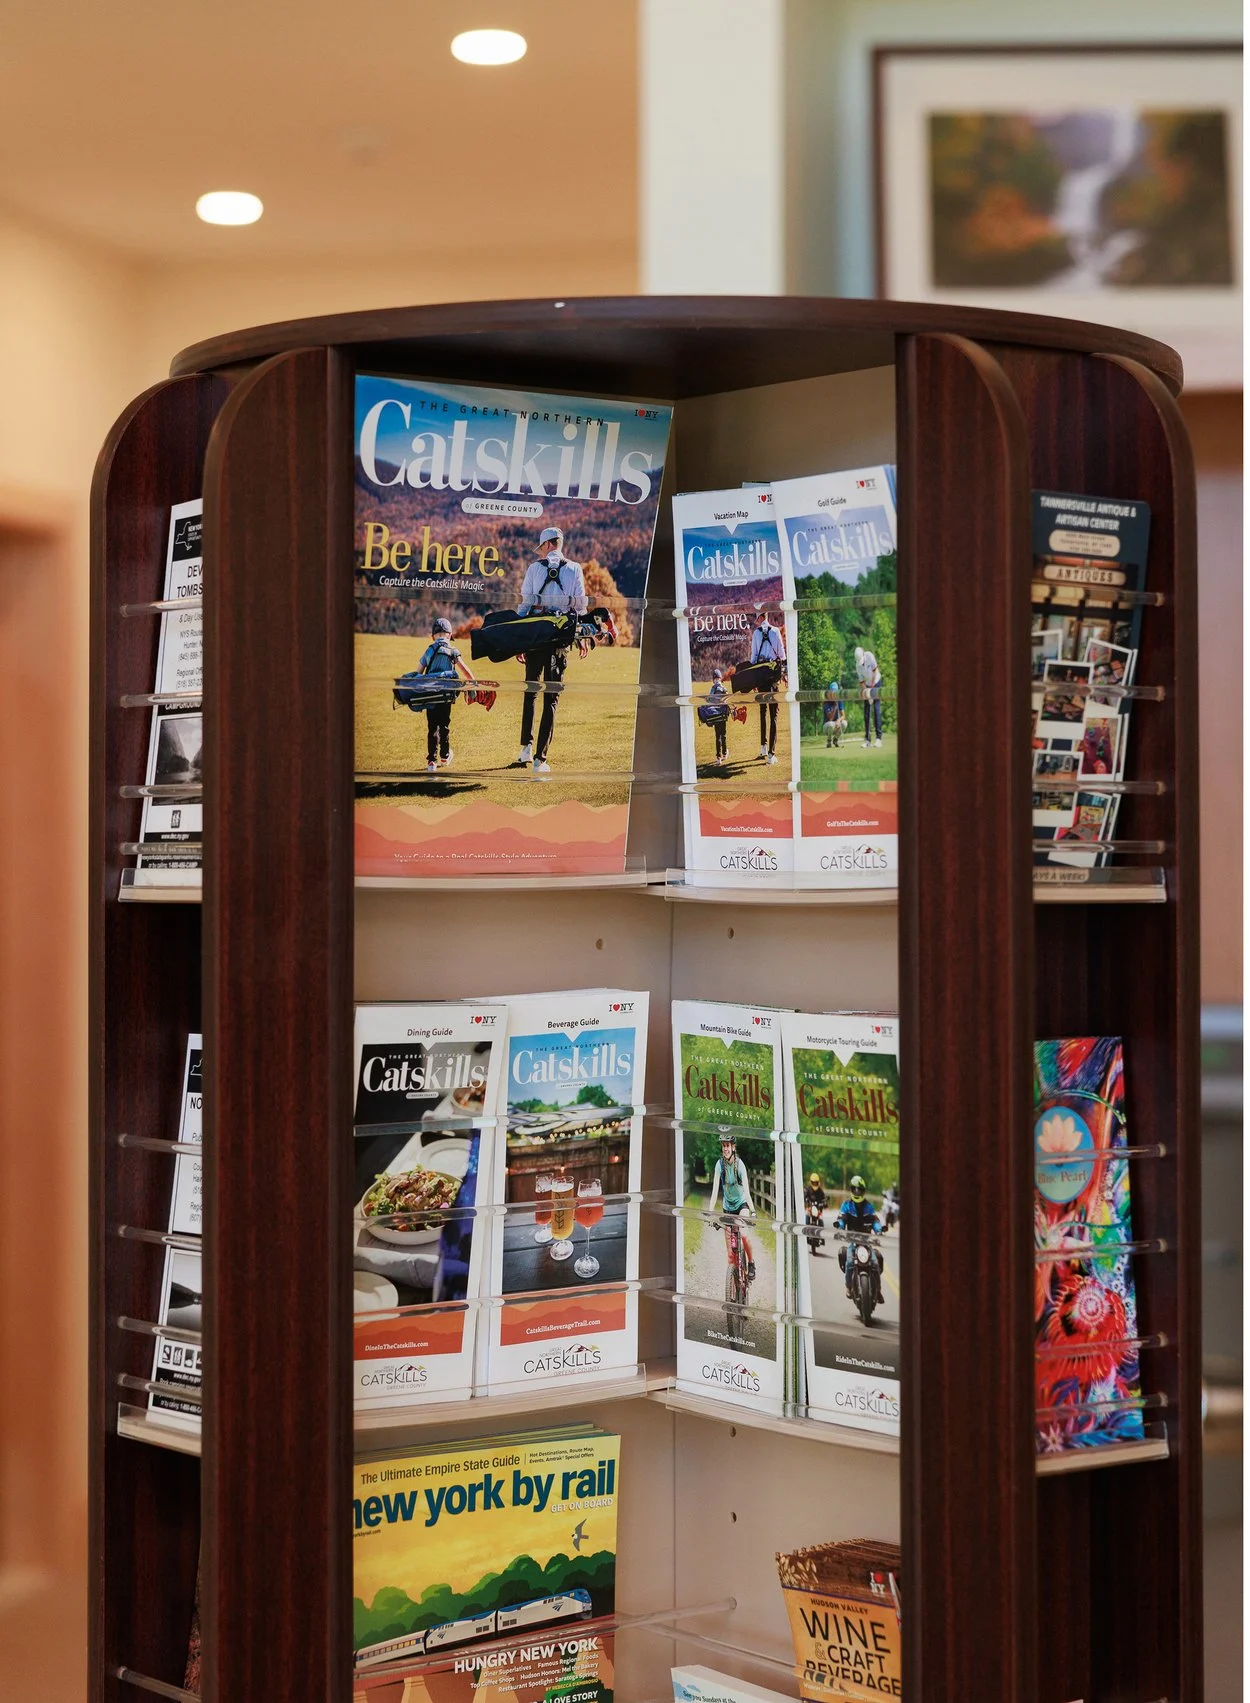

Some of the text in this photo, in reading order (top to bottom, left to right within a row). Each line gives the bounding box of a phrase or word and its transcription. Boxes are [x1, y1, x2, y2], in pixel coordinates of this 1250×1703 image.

[420, 401, 605, 426] THE GREAT NORTHERN
[360, 399, 652, 505] Catskills
[475, 503, 504, 511] GREENE
[818, 497, 846, 507] Golf Guide
[1097, 503, 1130, 517] ANTIQUE
[714, 511, 748, 520] Vacation Map
[1090, 518, 1120, 531] CENTER
[361, 522, 505, 577] Be here.
[793, 522, 893, 566] Catskills
[688, 540, 779, 580] Catskills
[188, 565, 203, 578] DEV
[177, 583, 203, 597] TOMBS
[379, 575, 411, 589] Capture
[411, 578, 425, 587] the
[461, 580, 484, 591] Magic
[548, 1018, 599, 1029] Beverage Guide
[700, 1024, 751, 1037] Mountain Bike Guide
[407, 1028, 453, 1038] Dining Guide
[806, 1035, 877, 1048] Motorcycle Touring Guide
[513, 1044, 631, 1084] Catskills
[363, 1055, 485, 1092] Catskills
[685, 1065, 771, 1110] Catskills
[799, 1083, 899, 1125] Catskills
[708, 1108, 733, 1117] GREENE
[736, 1112, 760, 1121] COUNTY
[825, 1127, 855, 1135] GREENE
[526, 1320, 600, 1334] CatskillsBeverageTrail.com
[365, 1342, 428, 1351] DineInTheCatskills.com
[708, 1330, 755, 1347] BikeTheCatskills.com
[524, 1350, 601, 1373] CATSKILLS
[361, 1368, 427, 1386] CATSKILLS
[702, 1365, 760, 1391] CATSKILLS
[361, 1455, 520, 1485] The Ultimate Empire State Guide
[353, 1459, 615, 1529] new york by rail
[551, 1498, 613, 1513] GET ON BOARD
[811, 1598, 868, 1615] HUDSON VALLEY
[800, 1607, 891, 1654] WINE
[454, 1637, 599, 1674] HUNGRY NEW YORK
[827, 1644, 885, 1673] CRAFT
[538, 1660, 558, 1668] Famous
[498, 1683, 528, 1692] Restaurant
[579, 1670, 599, 1679] Springs
[499, 1676, 515, 1685] Shops
[520, 1672, 540, 1680] Hudson
[572, 1691, 599, 1701] STORY
[683, 1690, 692, 1698] See
